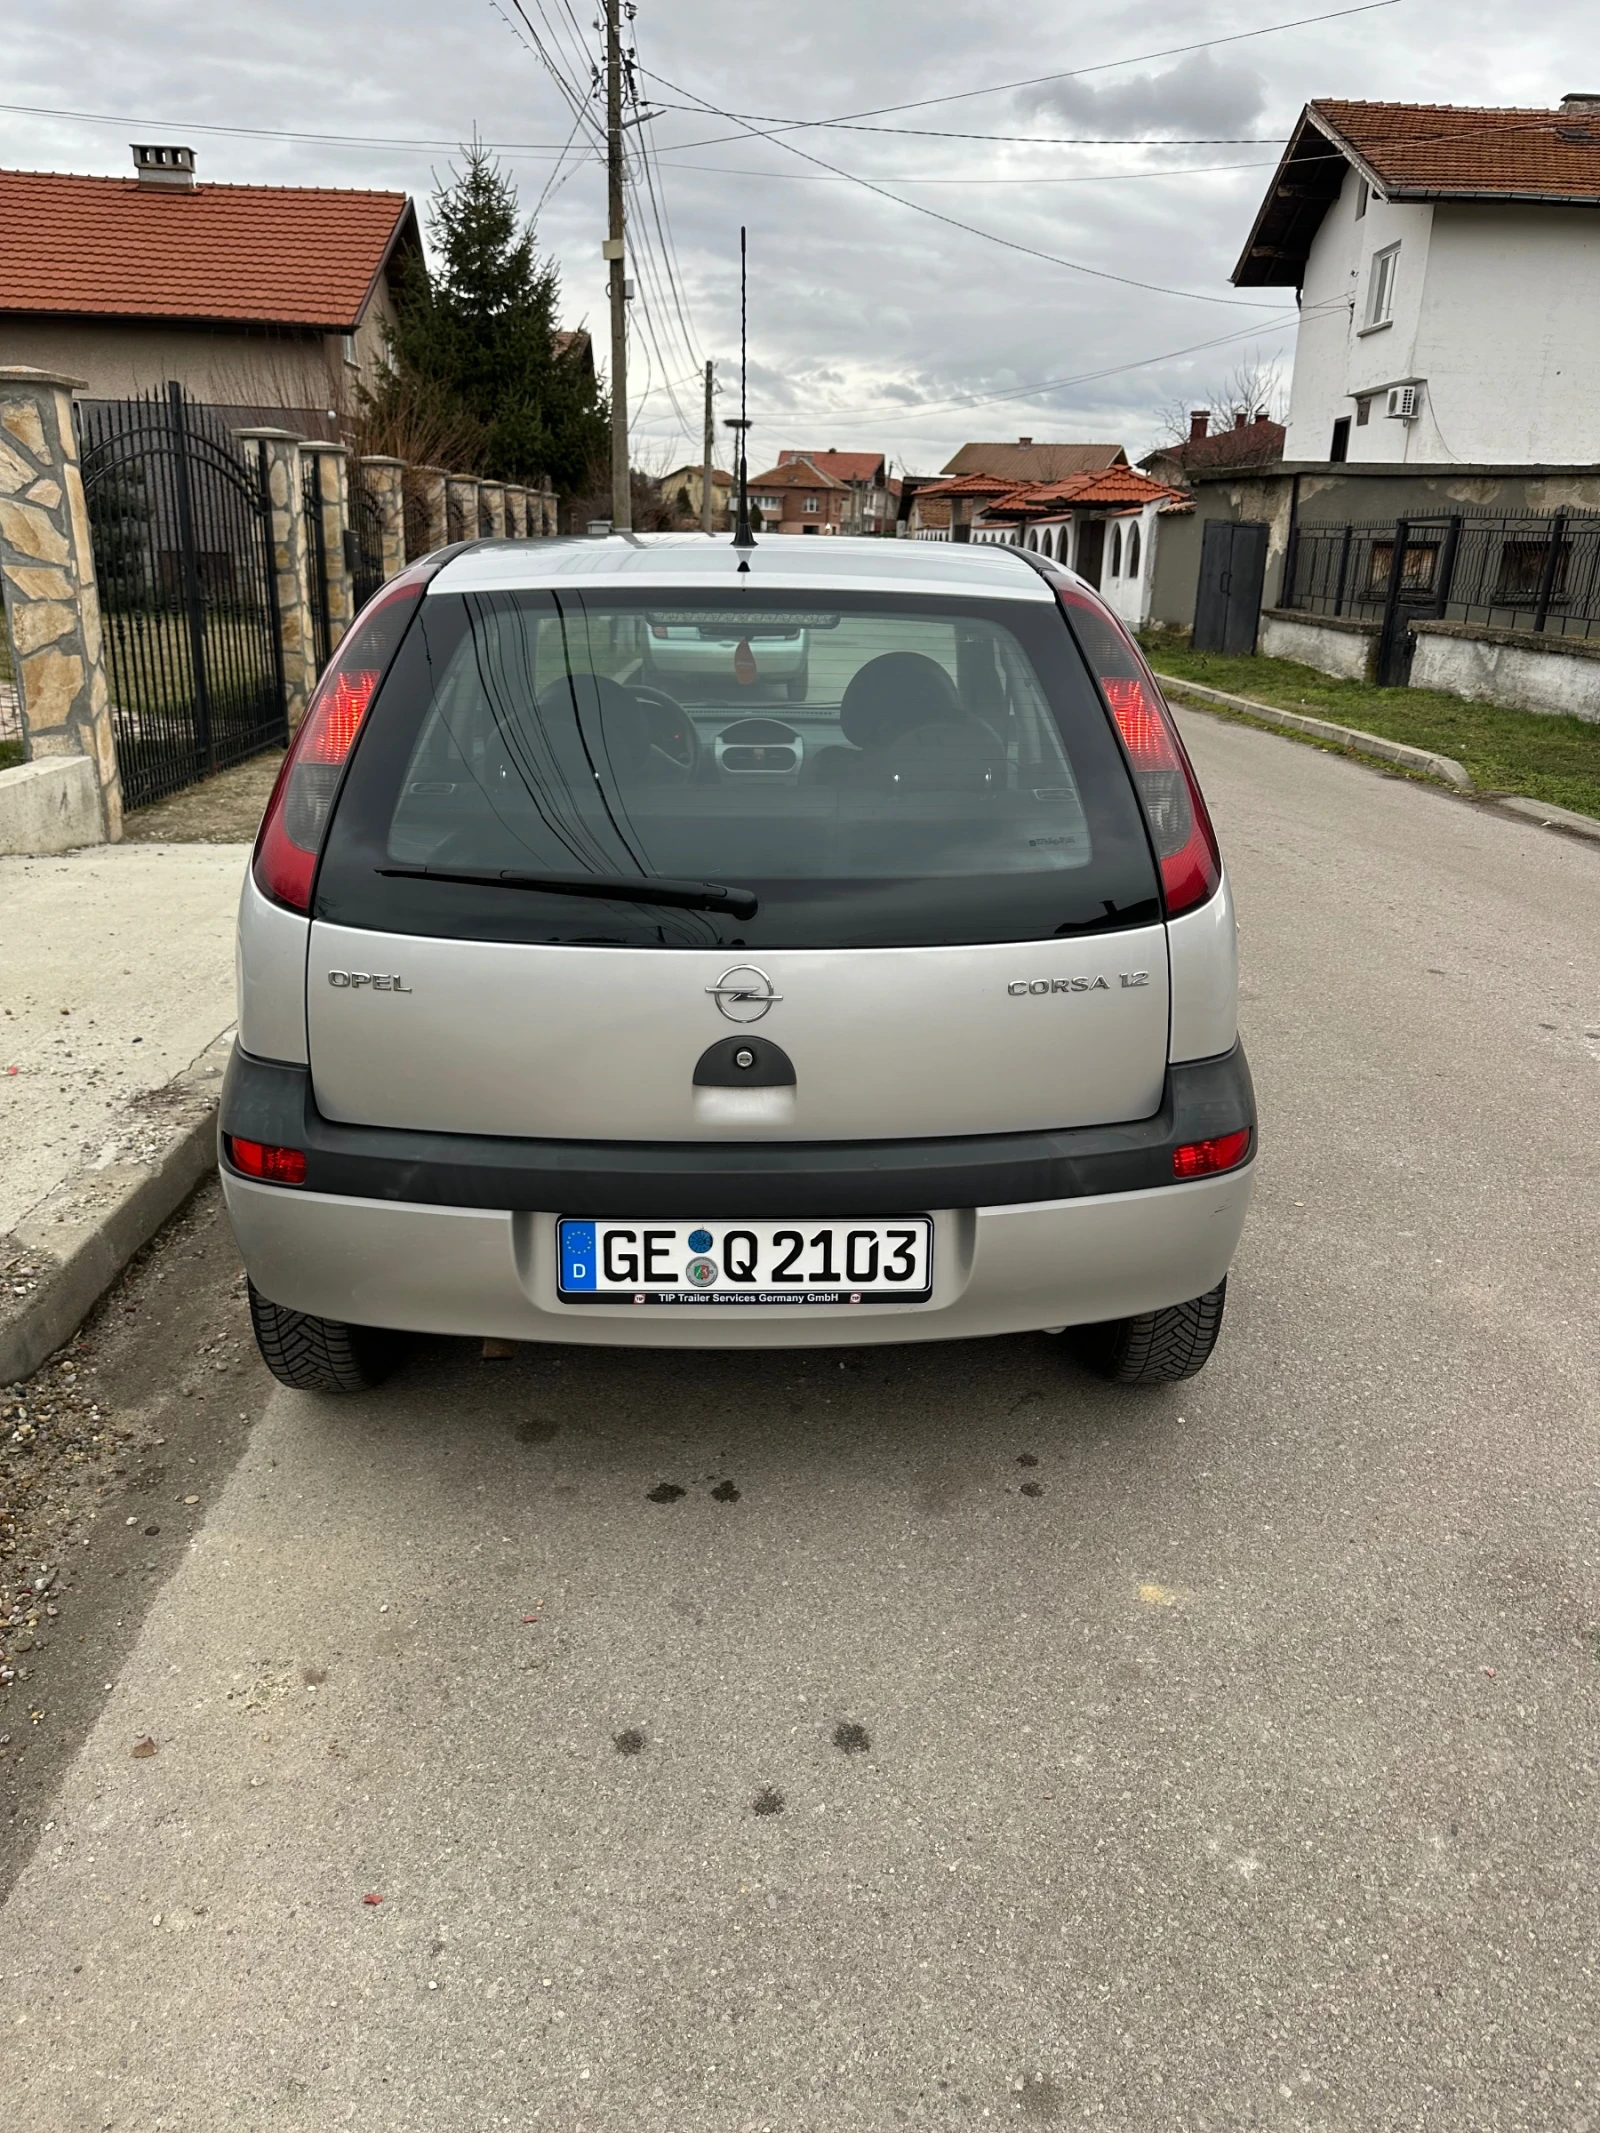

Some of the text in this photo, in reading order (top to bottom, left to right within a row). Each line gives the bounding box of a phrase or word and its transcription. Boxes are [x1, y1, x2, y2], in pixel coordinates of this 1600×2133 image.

[328, 970, 413, 994] OPEL
[1007, 975, 1110, 996] CORSA
[603, 1230, 679, 1283] GE
[723, 1230, 758, 1283] Q
[771, 1230, 917, 1283] 2103
[572, 1263, 586, 1279] D
[658, 1293, 839, 1304] TIP Trailer Services Germany GmbH
